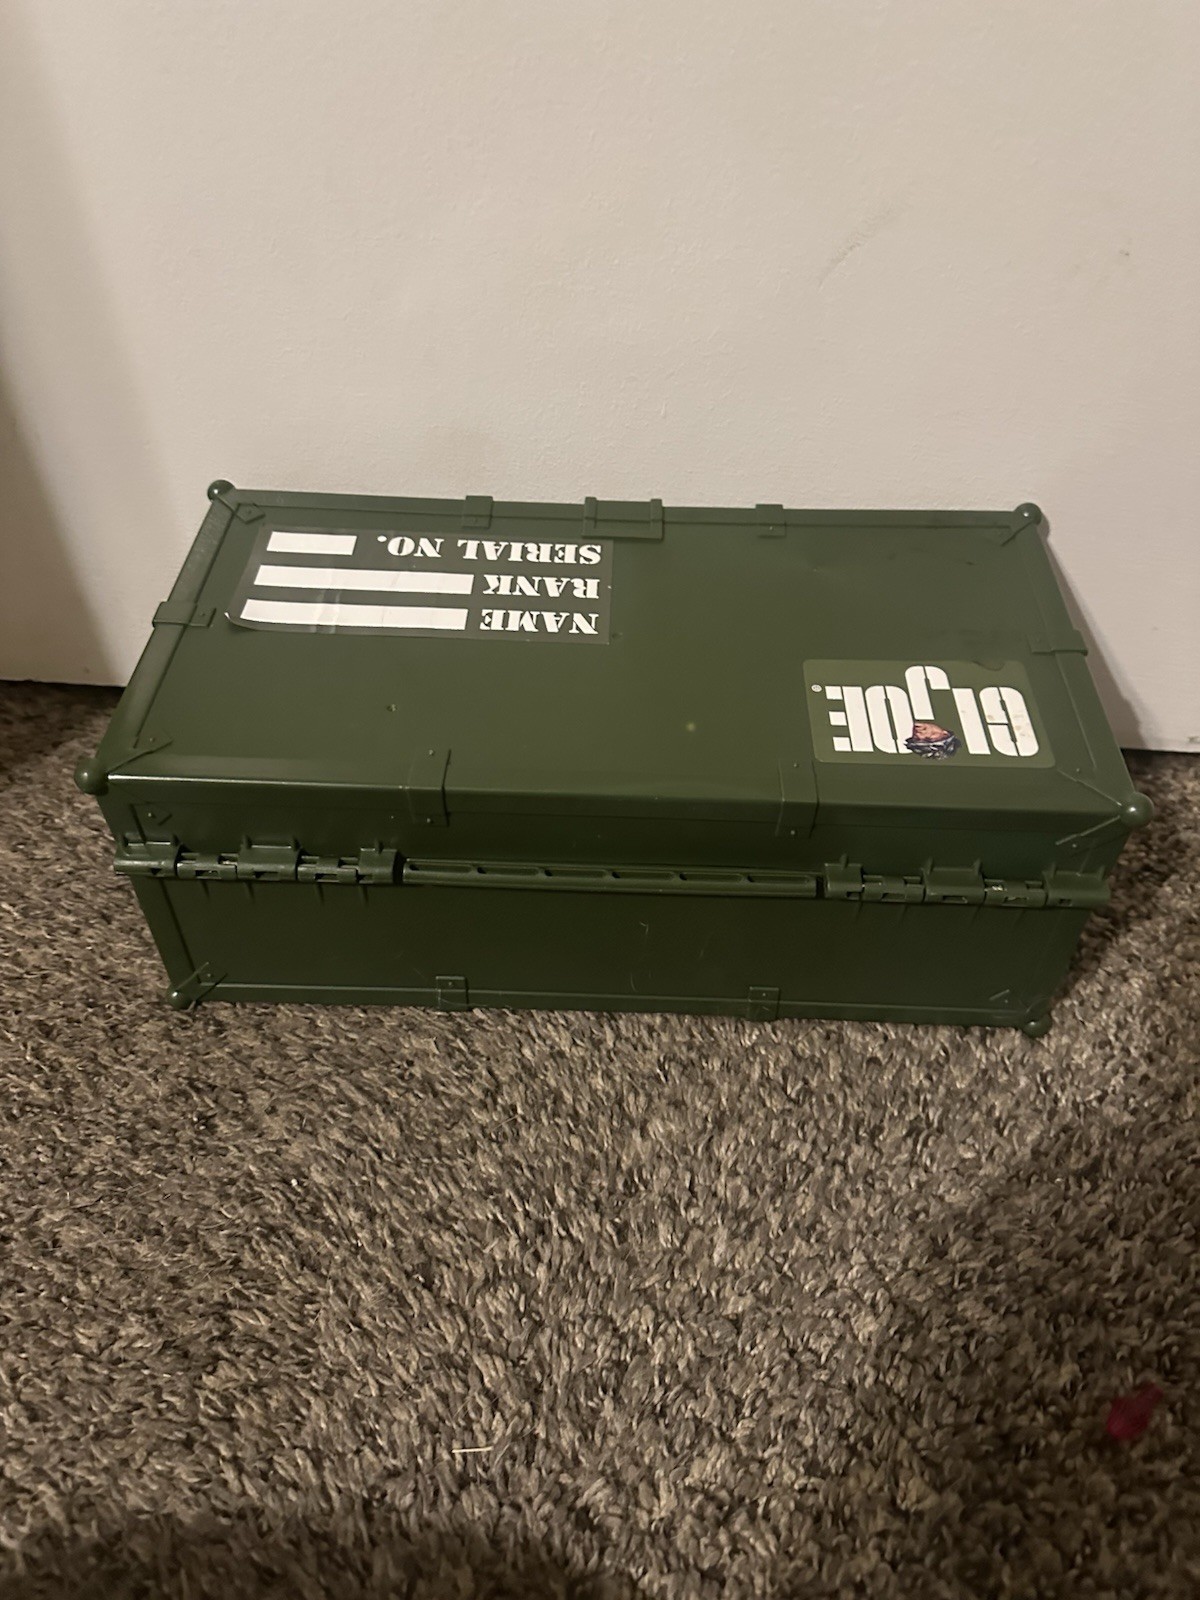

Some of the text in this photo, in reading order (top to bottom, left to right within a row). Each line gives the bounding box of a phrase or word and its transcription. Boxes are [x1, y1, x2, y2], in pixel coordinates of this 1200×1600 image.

[376, 535, 602, 565] SERIAL NO.
[482, 573, 601, 600] RANK
[480, 608, 600, 635] NAME
